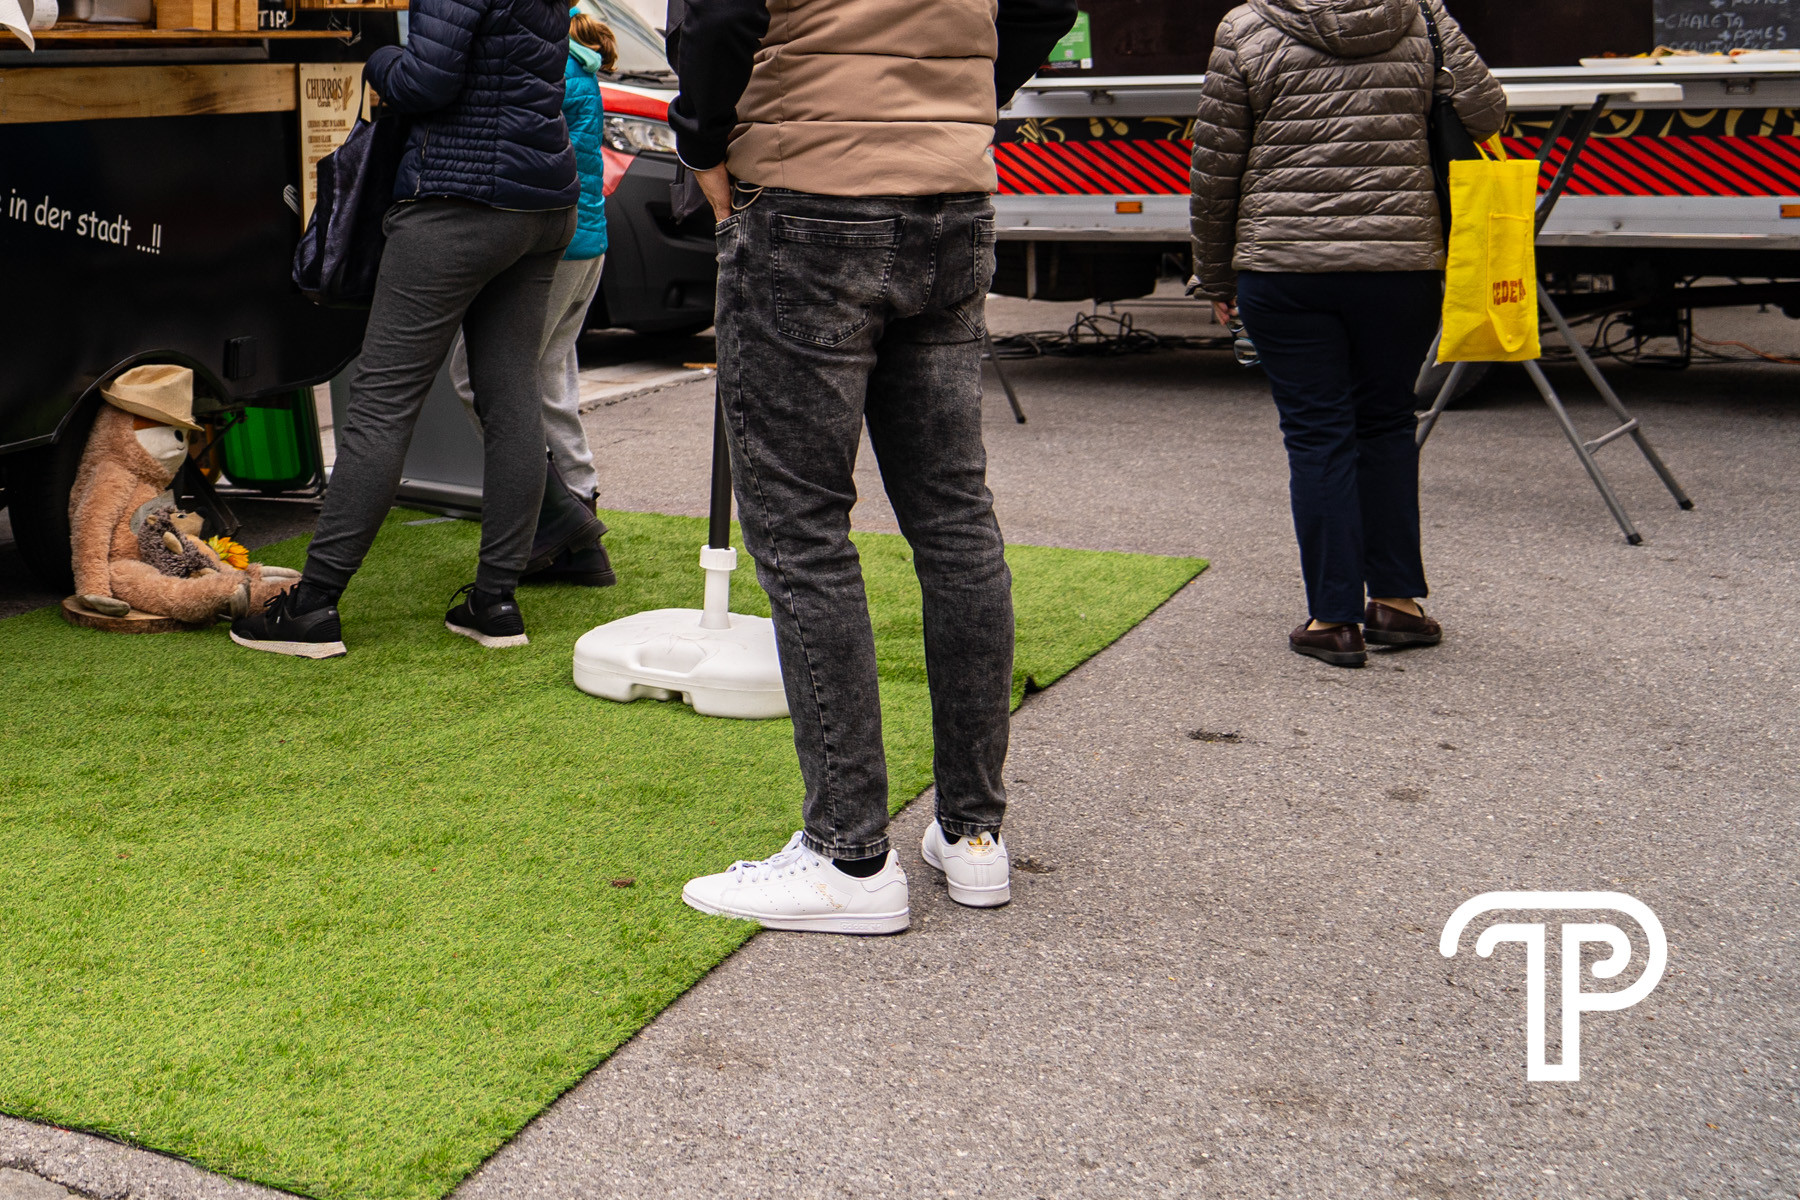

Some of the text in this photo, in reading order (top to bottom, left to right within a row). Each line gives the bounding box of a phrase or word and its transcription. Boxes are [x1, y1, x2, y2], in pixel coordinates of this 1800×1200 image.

[306, 77, 343, 100] CHURROS
[9, 188, 27, 222] in
[34, 195, 72, 231] der
[76, 211, 132, 247] stadt
